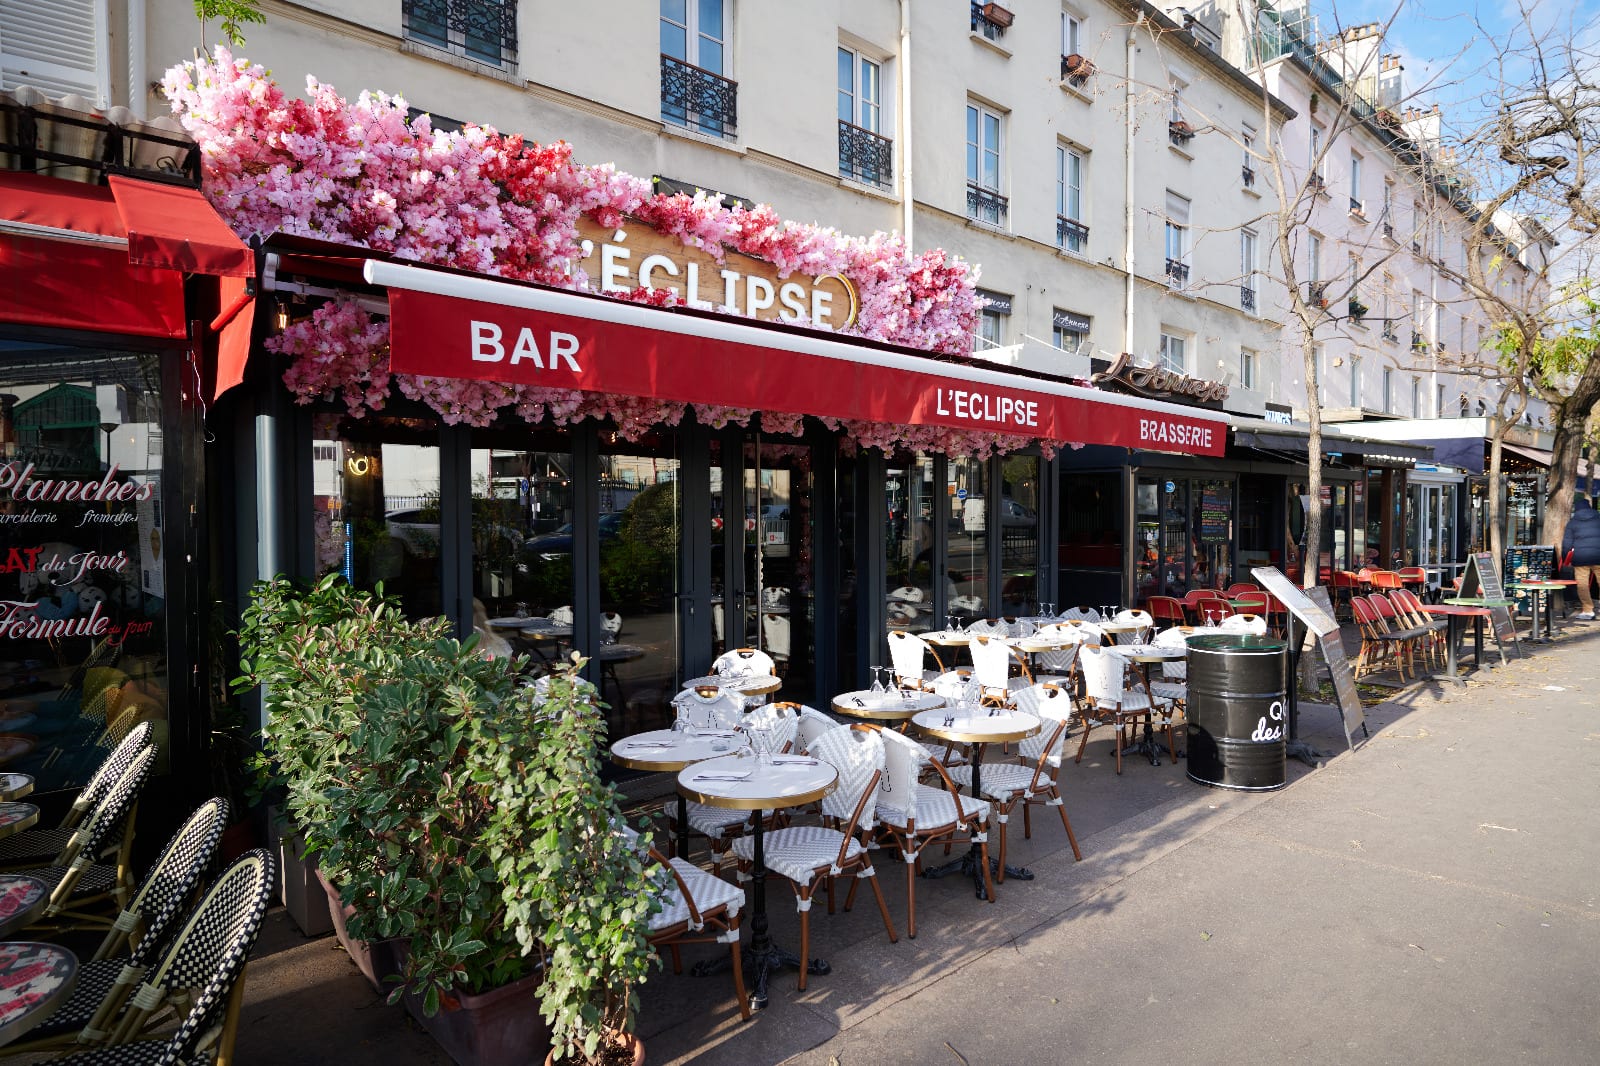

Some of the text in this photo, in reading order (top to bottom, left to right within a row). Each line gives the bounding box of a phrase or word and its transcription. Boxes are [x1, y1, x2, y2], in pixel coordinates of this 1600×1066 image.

[563, 229, 833, 331] 'ÉCLIPSE
[470, 319, 582, 373] BAR
[936, 387, 1038, 427] L'ECLIPSE
[1139, 418, 1212, 448] BRASSERIE
[74, 509, 139, 528] fromages
[0, 545, 43, 573] AT
[41, 553, 67, 572] du
[0, 599, 111, 640] Formule
[1251, 716, 1282, 741] des
